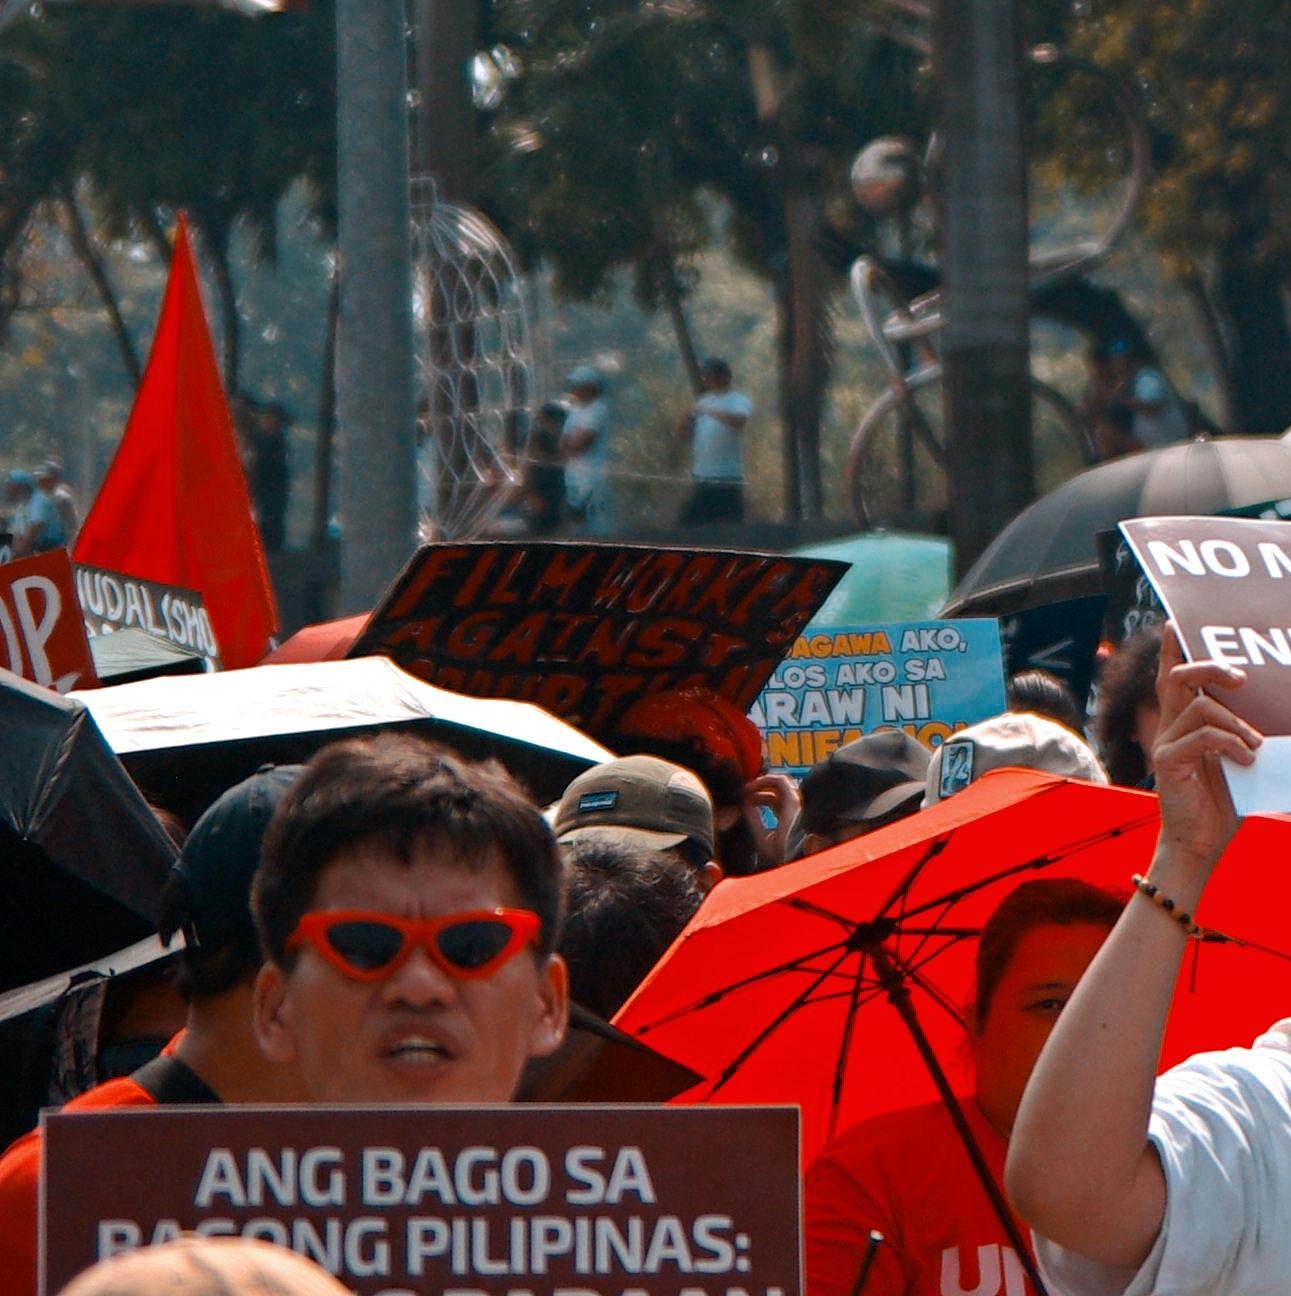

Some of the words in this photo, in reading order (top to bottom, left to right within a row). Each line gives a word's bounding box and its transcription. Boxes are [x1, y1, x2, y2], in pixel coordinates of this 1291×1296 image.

[383, 549, 598, 622] FILM
[1147, 539, 1251, 578] NO
[77, 568, 217, 657] UDALISMO
[386, 609, 752, 668] AGAINST
[785, 630, 892, 660] AGAWA
[900, 626, 968, 654] AKO,
[764, 664, 828, 692] LOS
[835, 660, 897, 688] AKO
[904, 657, 946, 682] SA
[881, 683, 931, 722] NI
[193, 1145, 347, 1208] ANG
[361, 1144, 551, 1207] BAGO
[563, 1144, 658, 1206] SA
[405, 1213, 751, 1277] PILIPINAS:
